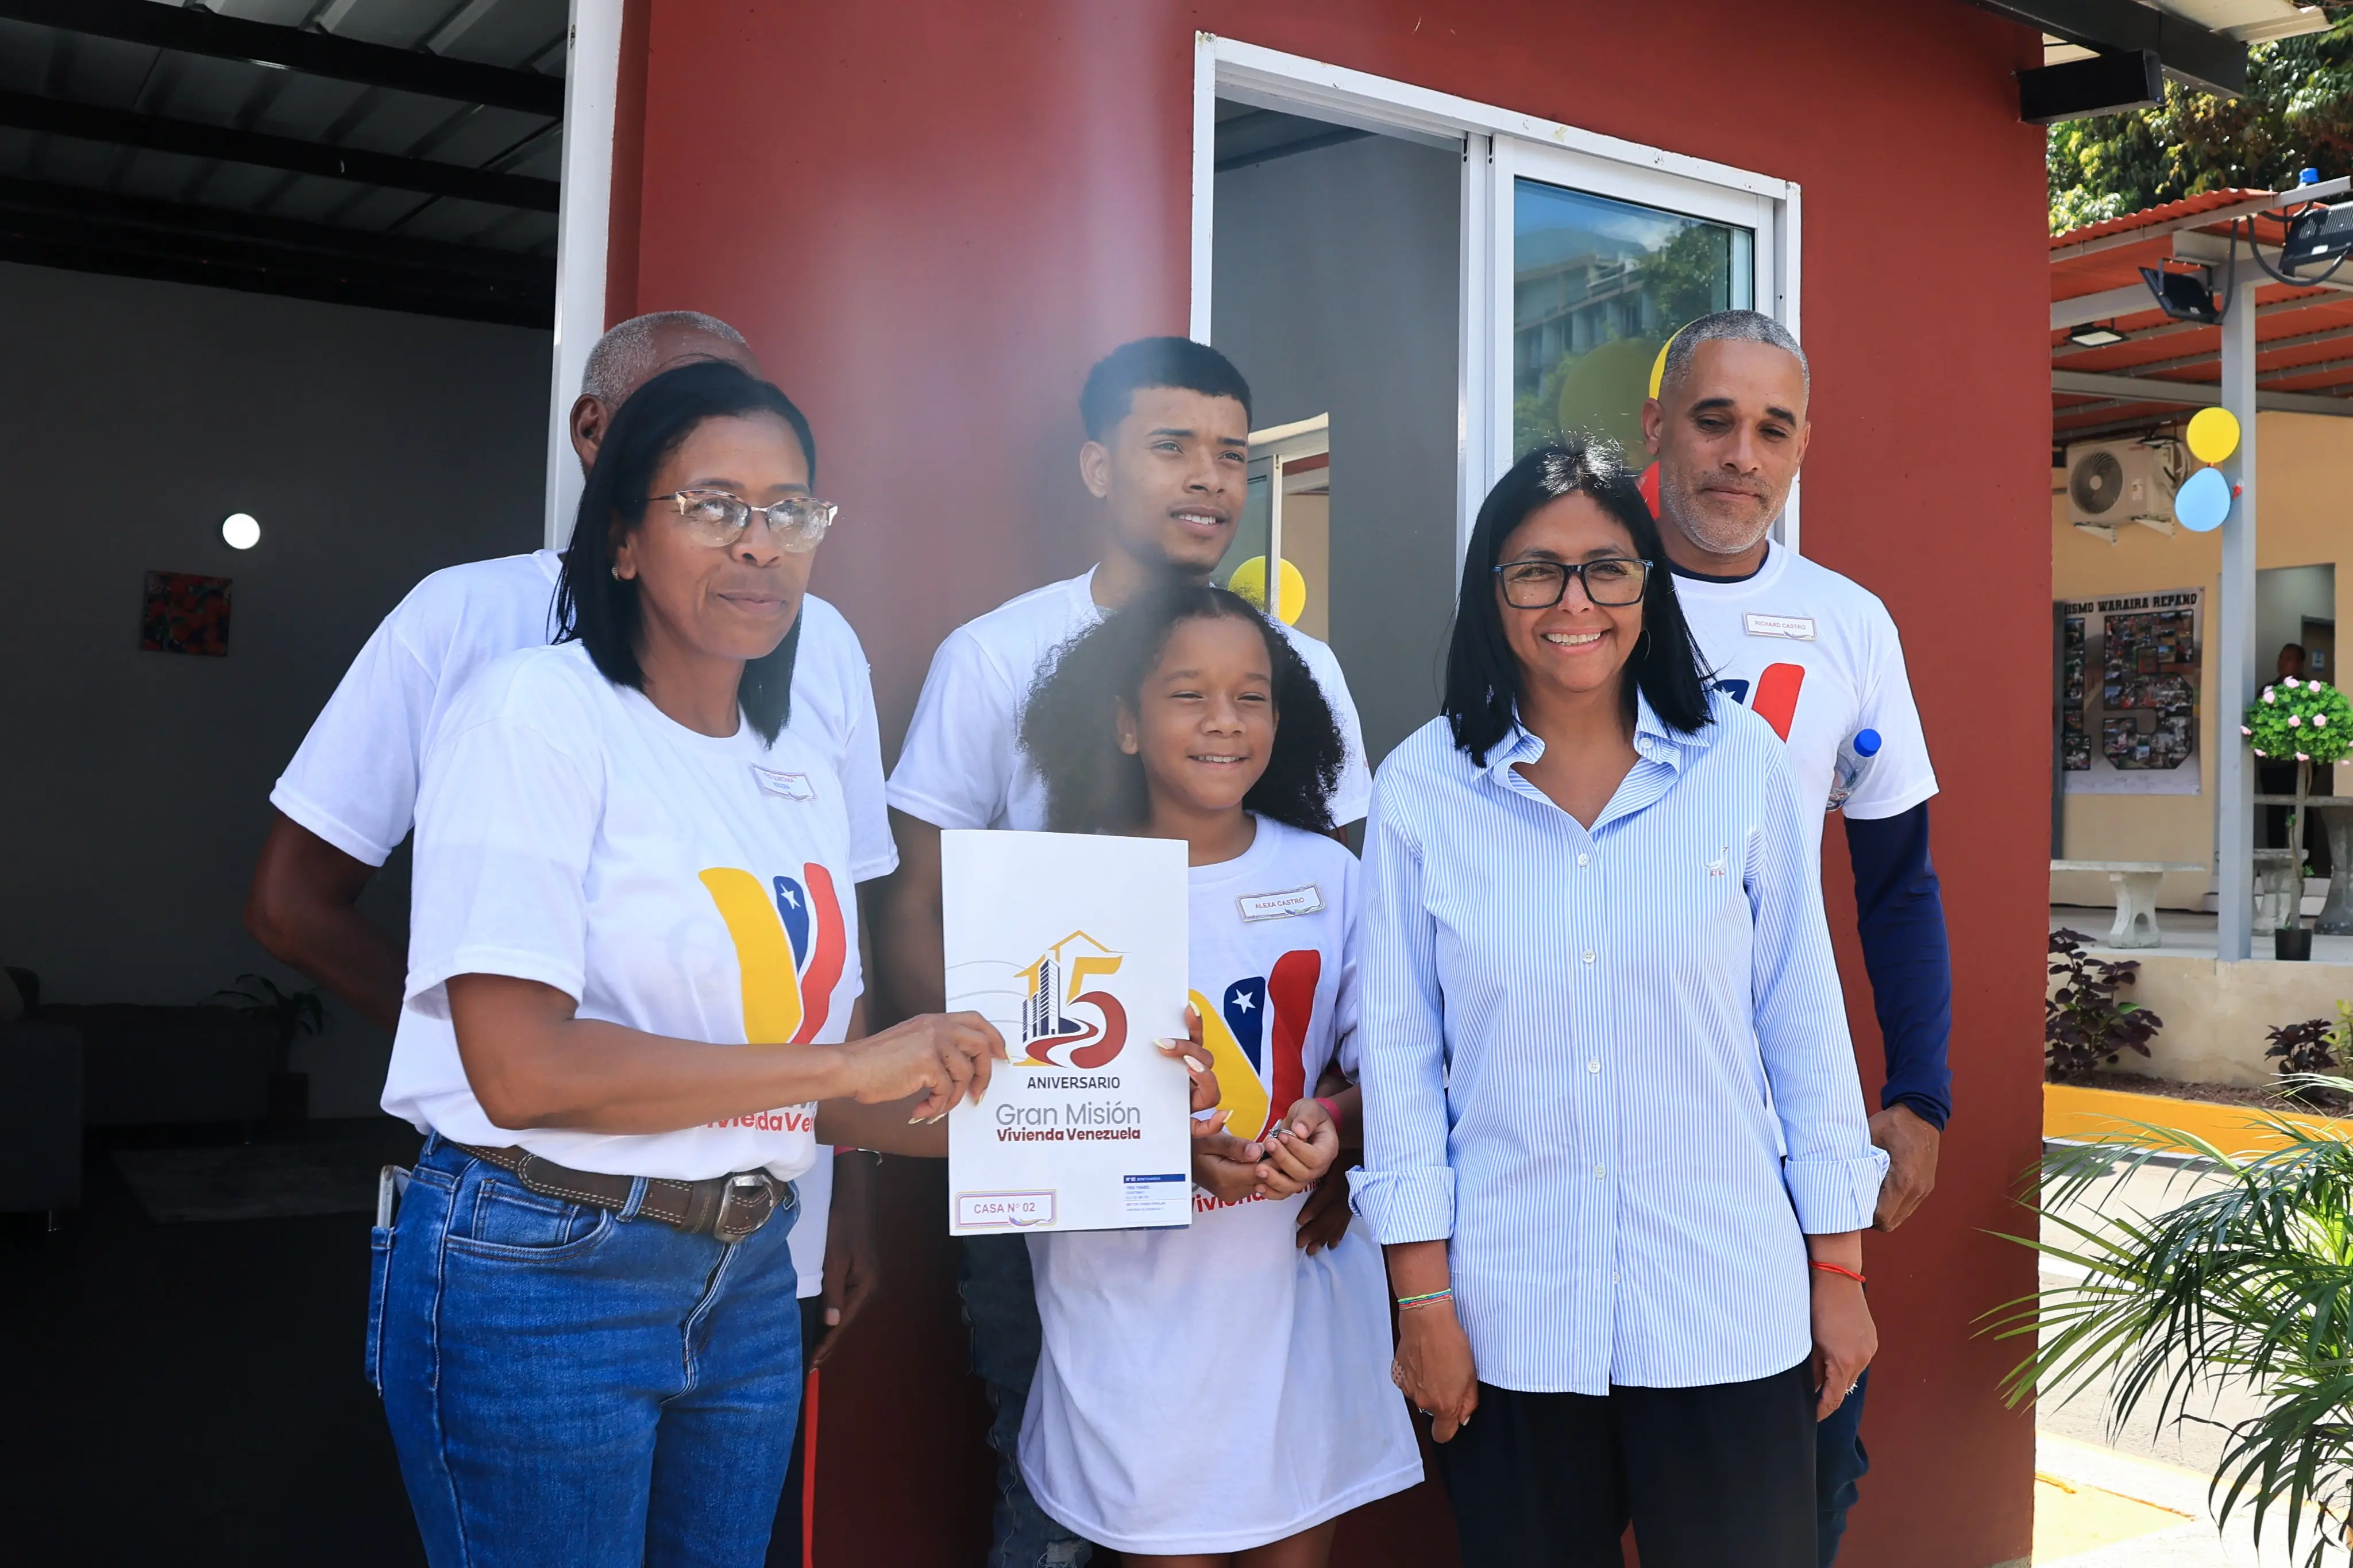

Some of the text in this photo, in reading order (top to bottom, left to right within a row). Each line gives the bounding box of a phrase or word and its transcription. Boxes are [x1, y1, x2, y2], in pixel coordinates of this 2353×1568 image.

[2098, 597, 2149, 612] WARAIRA
[1255, 897, 1305, 909] ALEXA CASTRO
[1027, 1076, 1121, 1089] ANIVERSARIO
[996, 1101, 1141, 1126] Gran Misión
[997, 1127, 1141, 1142] Vivienda Venezuela
[974, 1203, 1005, 1214] CASA
[1023, 1202, 1036, 1212] 02
